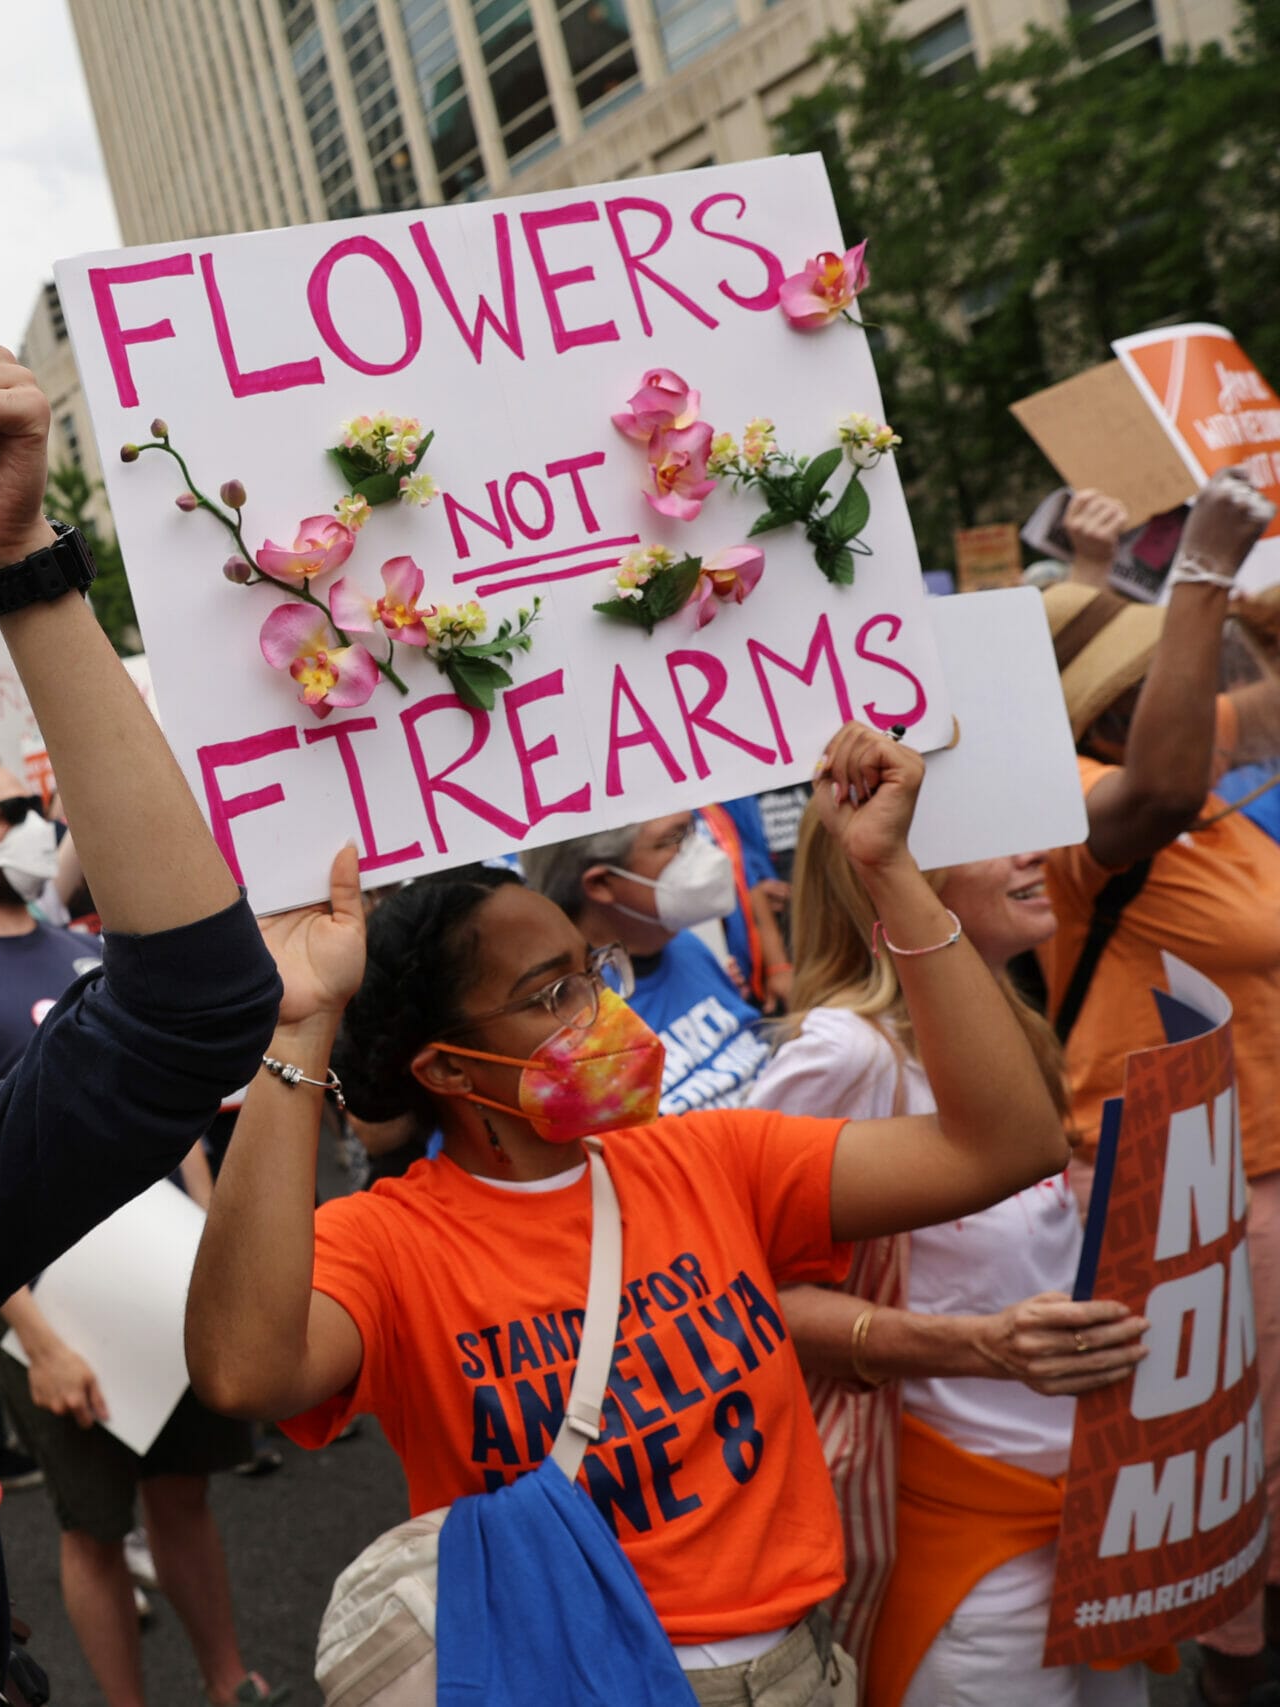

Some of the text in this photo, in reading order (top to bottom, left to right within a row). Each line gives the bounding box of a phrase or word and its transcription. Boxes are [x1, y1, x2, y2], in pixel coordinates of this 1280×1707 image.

[88, 192, 786, 408] FLOWERS
[442, 451, 606, 559] NOT
[197, 613, 927, 886] FIREARMS
[455, 1309, 586, 1379] STAND
[626, 1252, 711, 1329] FOR
[714, 1390, 764, 1485] 8
[1097, 1391, 1265, 1559] MOR
